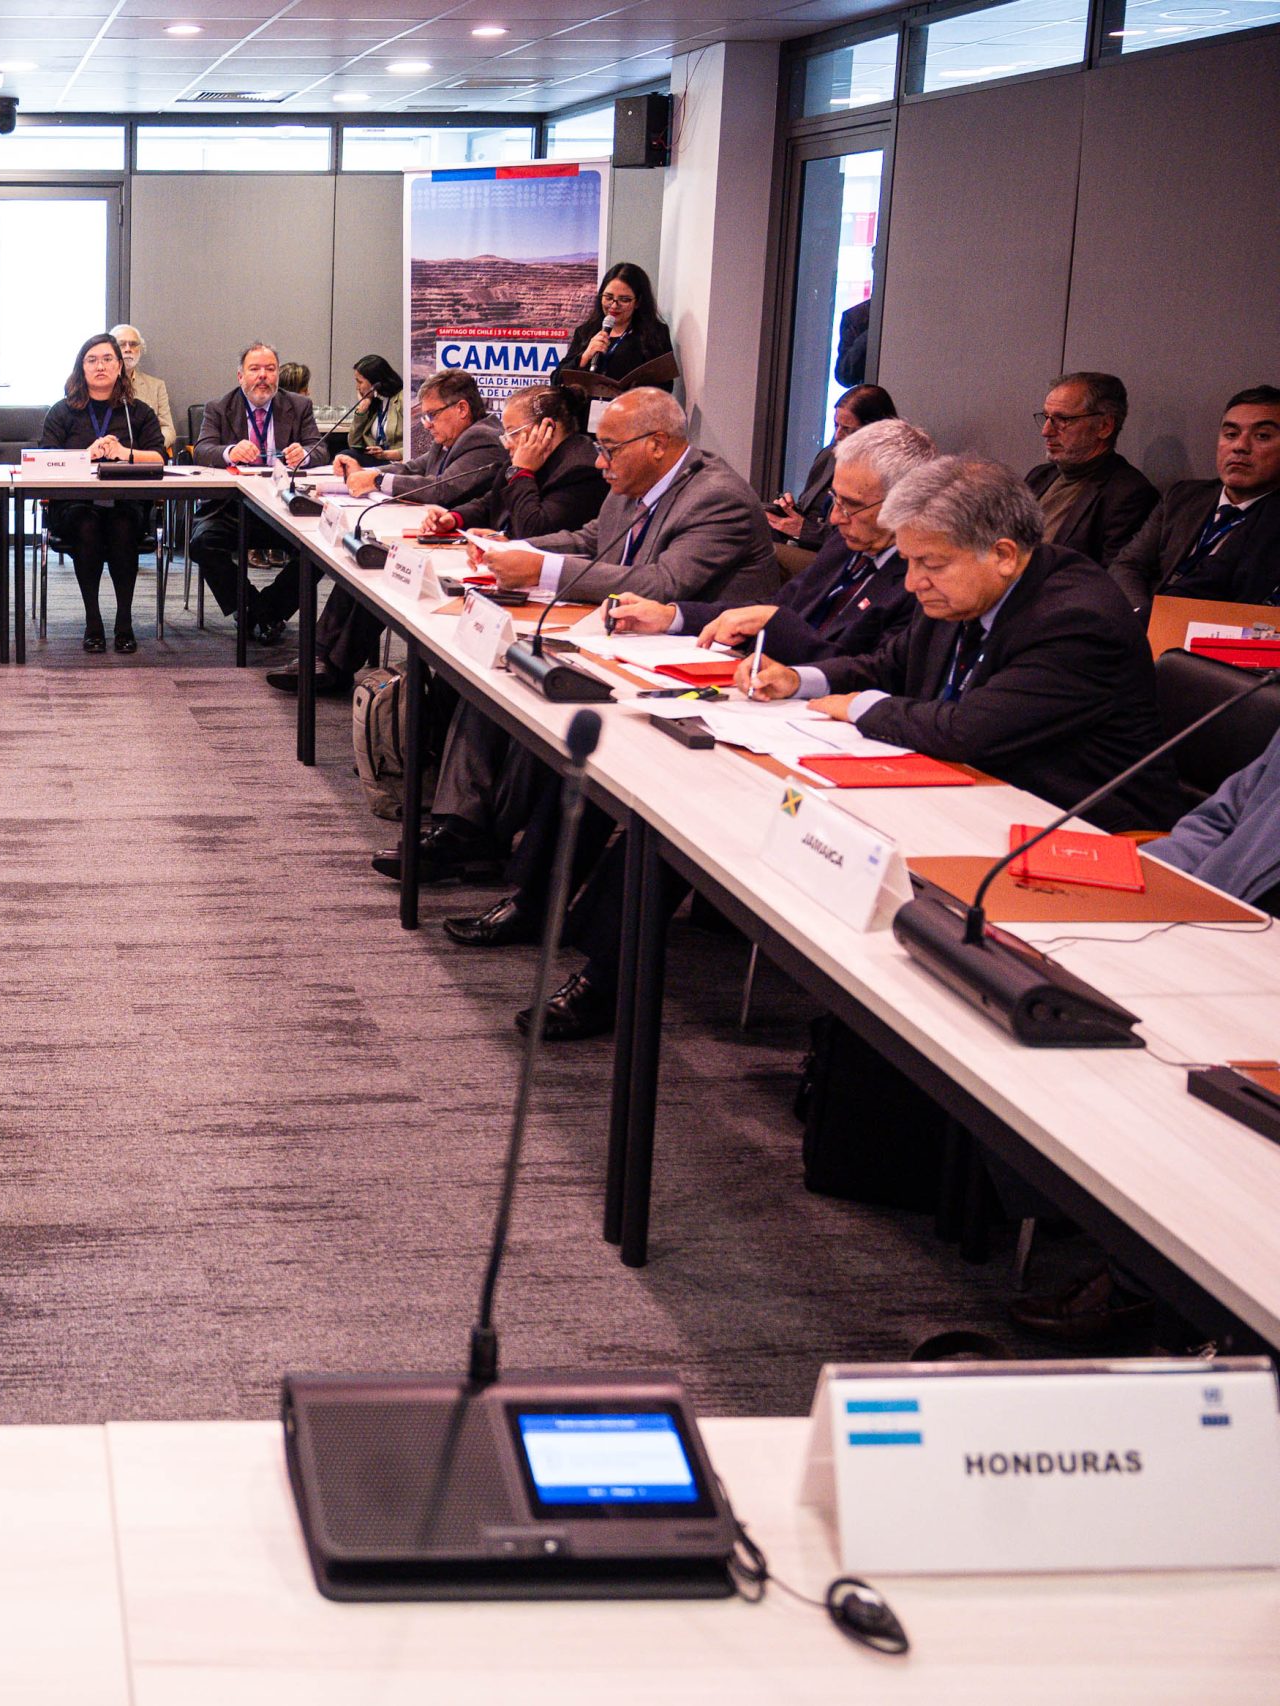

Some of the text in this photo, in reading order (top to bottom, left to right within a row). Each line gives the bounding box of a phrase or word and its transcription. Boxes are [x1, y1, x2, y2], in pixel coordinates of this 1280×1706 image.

[441, 344, 560, 372] CAMMA
[487, 389, 500, 397] DE
[501, 389, 513, 397] LA
[496, 377, 509, 386] DE
[511, 378, 549, 386] MINISTE
[801, 833, 844, 868] JAMAICA
[964, 1450, 1144, 1476] HONDURAS
